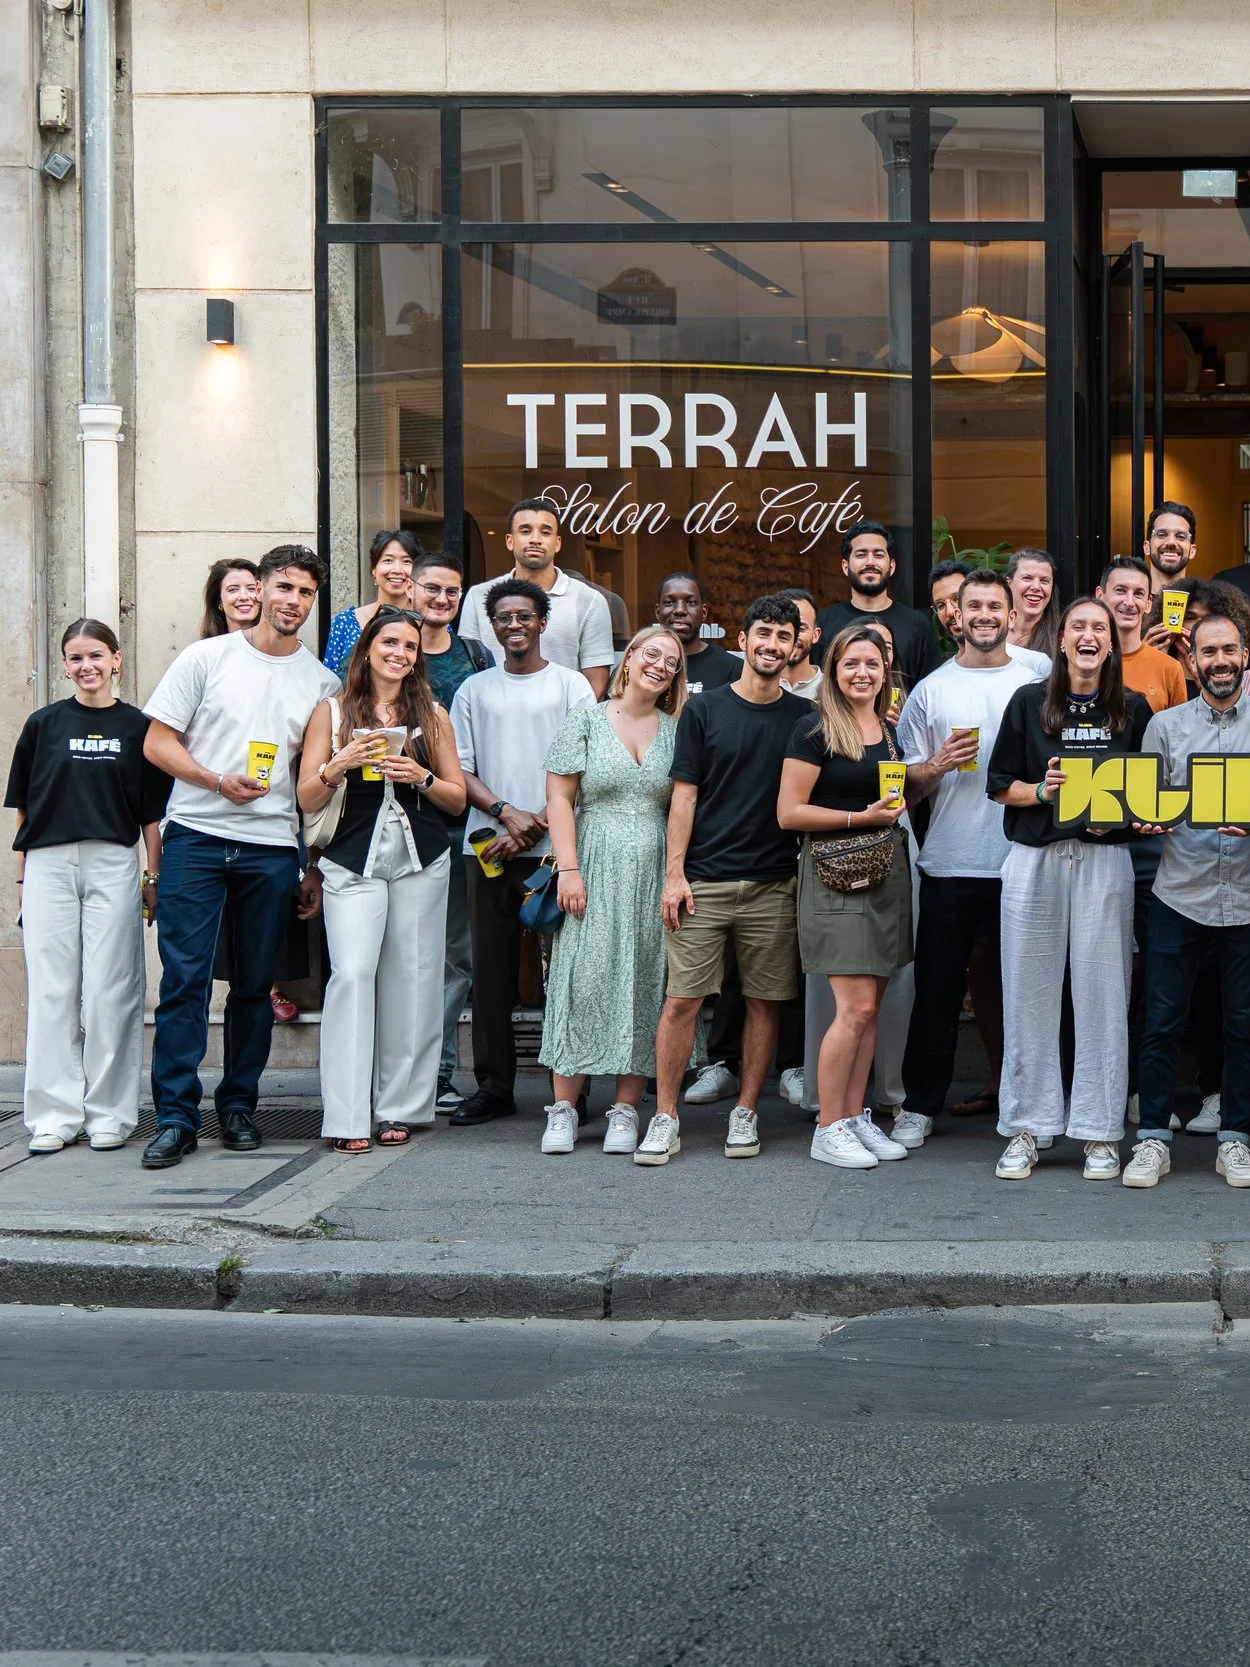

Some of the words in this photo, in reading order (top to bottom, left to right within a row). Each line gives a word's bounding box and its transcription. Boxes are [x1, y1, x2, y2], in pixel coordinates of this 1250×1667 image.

[507, 392, 867, 469] TERRAH
[532, 481, 671, 535] Salon
[683, 481, 740, 535] de
[756, 480, 865, 554] Café
[686, 681, 704, 694] FÉ
[69, 738, 121, 753] KAFÉ
